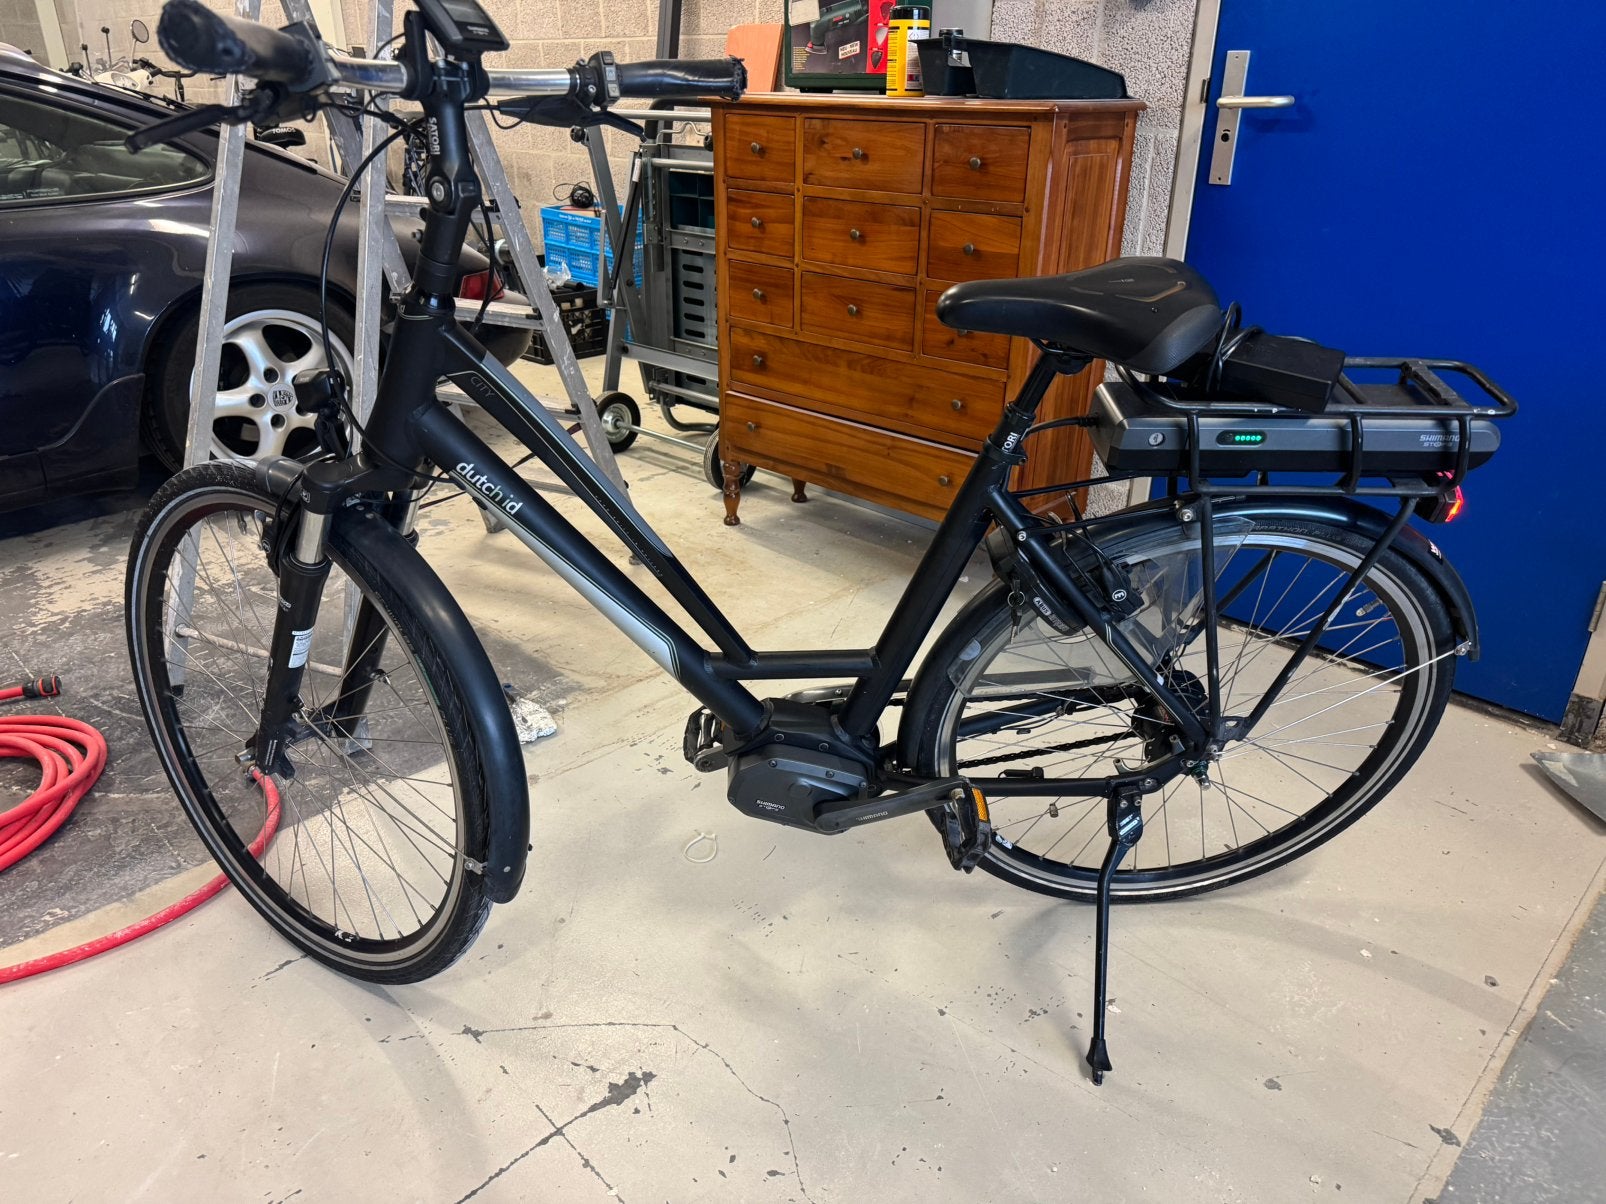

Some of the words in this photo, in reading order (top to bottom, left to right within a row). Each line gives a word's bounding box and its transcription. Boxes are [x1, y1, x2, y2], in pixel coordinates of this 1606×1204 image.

[428, 116, 441, 155] SATORI
[470, 376, 496, 398] CITY
[456, 462, 504, 502] dutch
[501, 494, 524, 515] id
[1034, 599, 1050, 615] ABUS
